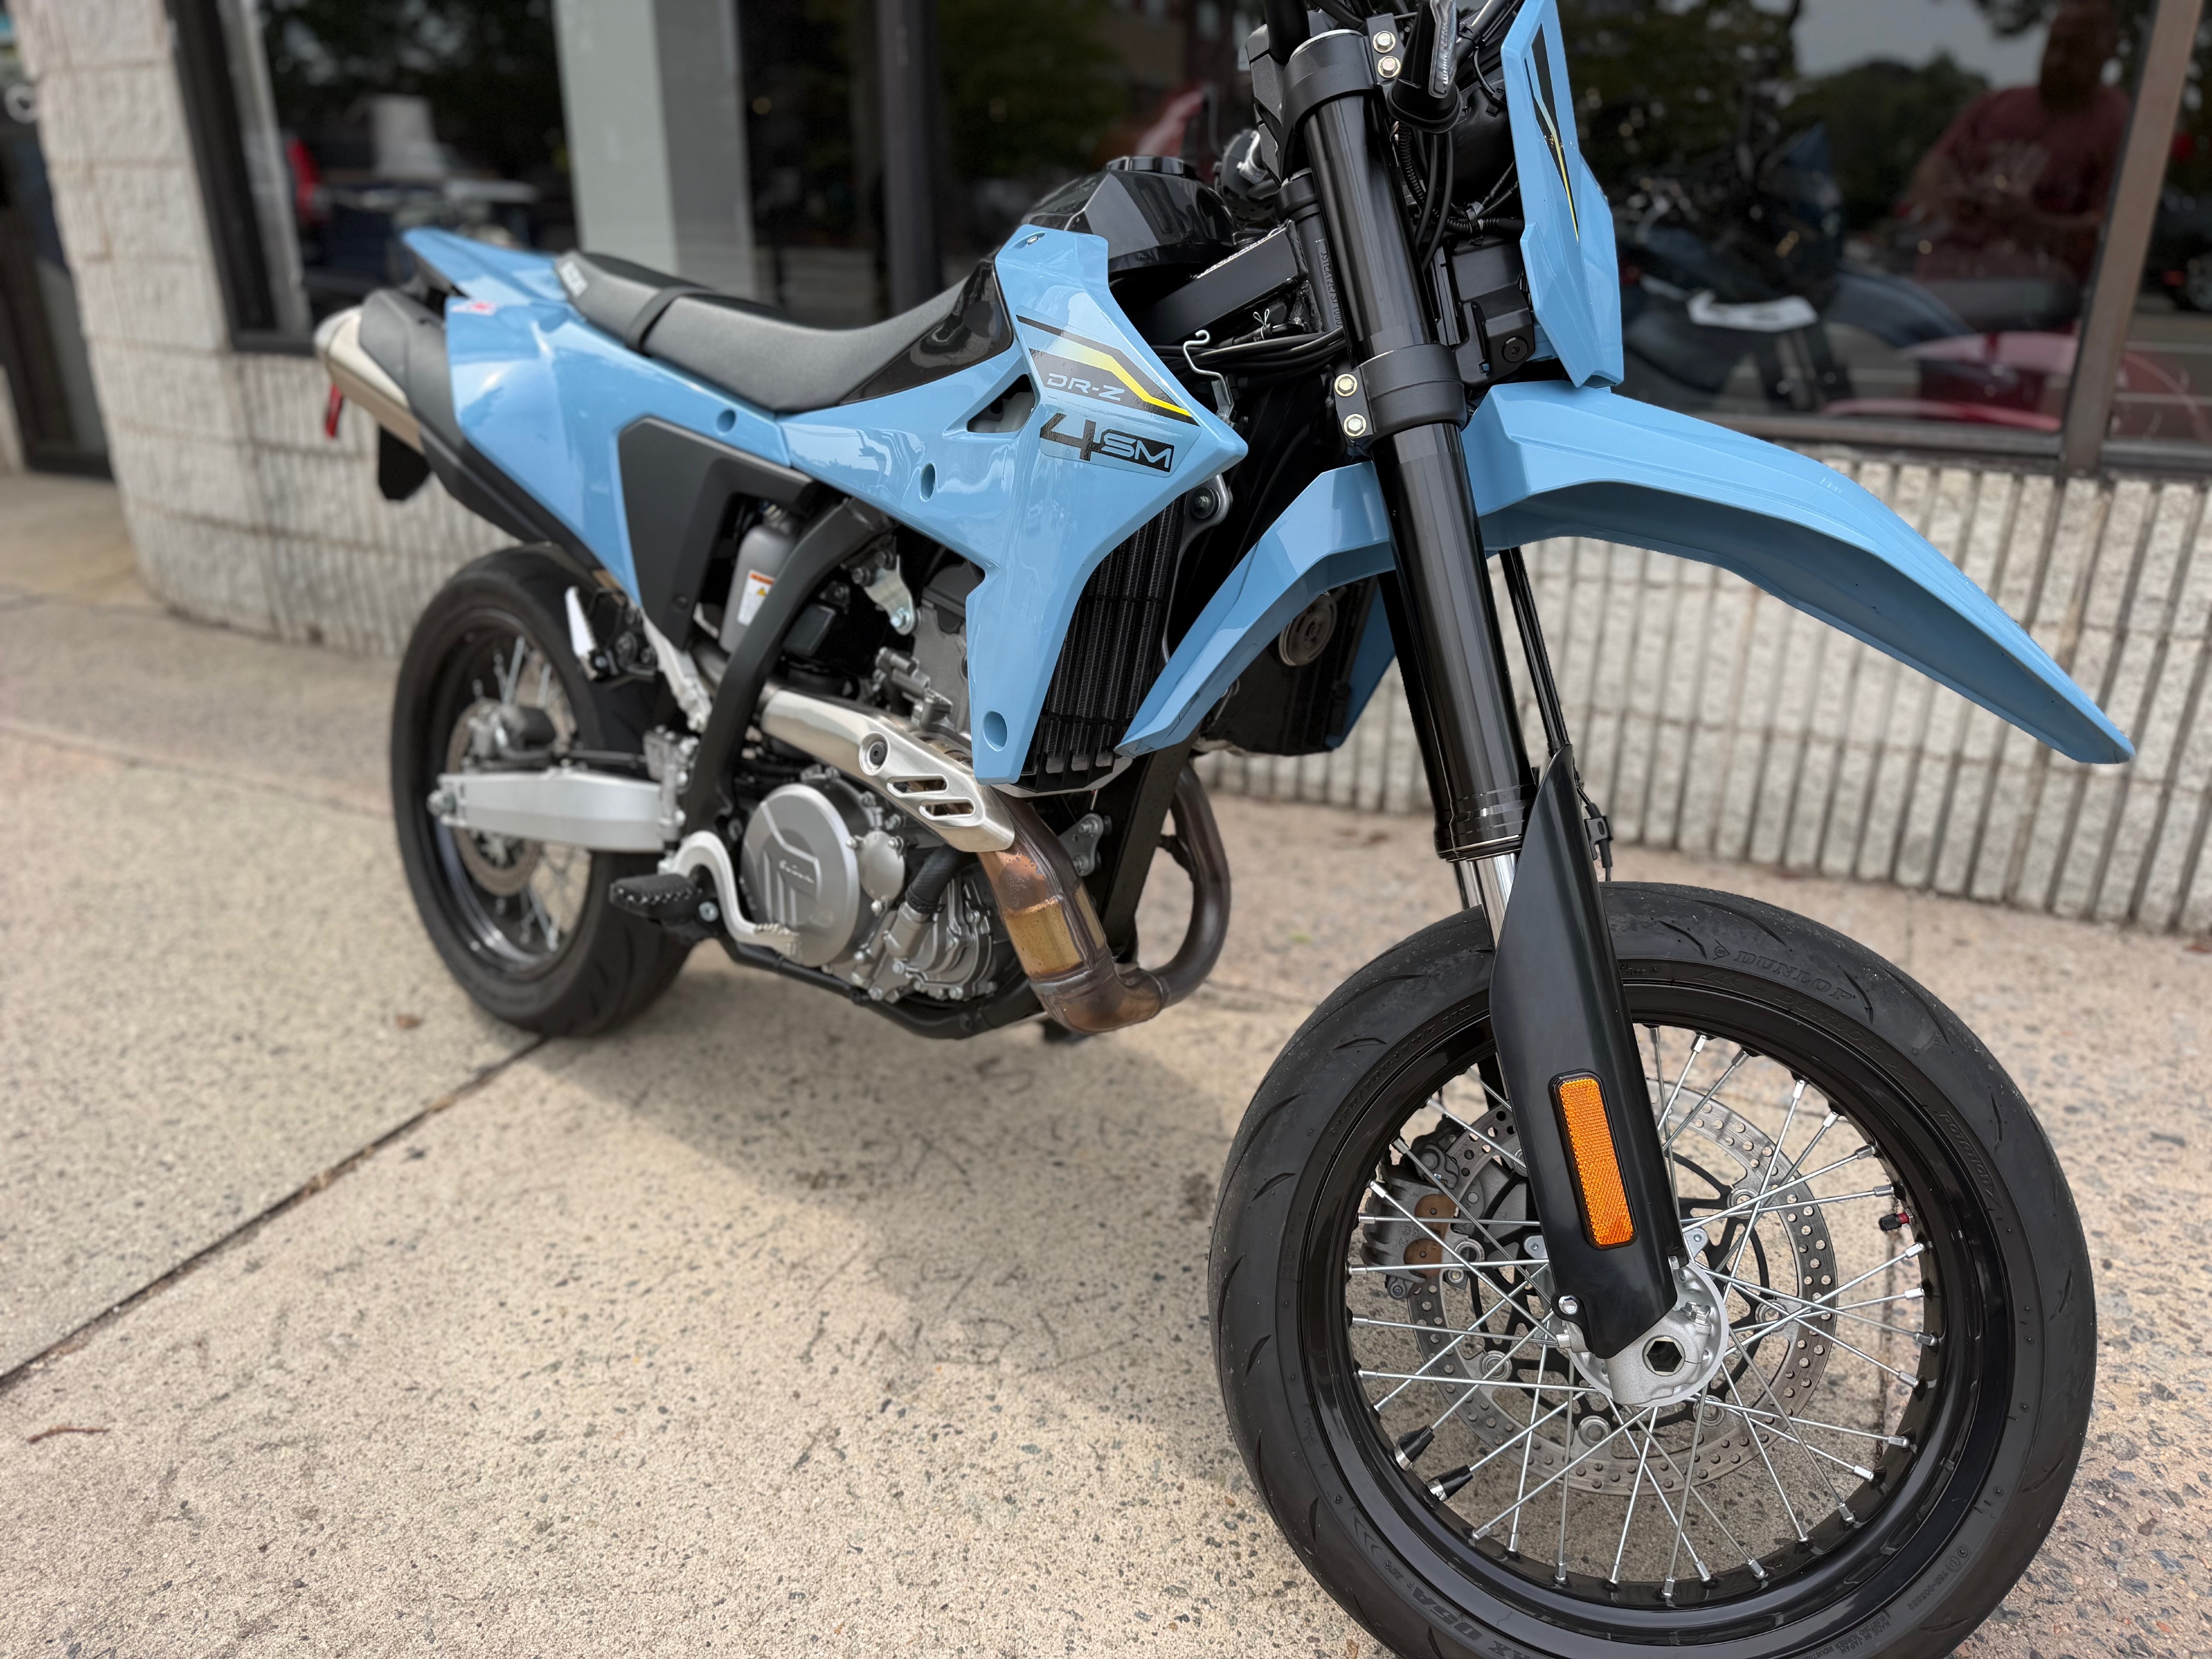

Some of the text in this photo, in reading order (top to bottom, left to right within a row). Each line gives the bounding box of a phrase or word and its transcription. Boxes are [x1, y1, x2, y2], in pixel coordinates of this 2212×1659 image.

[1047, 372, 1125, 401] DR-Z
[1733, 950, 1853, 1000] DUNLOP
[1775, 992, 1885, 1052] DUNLOP
